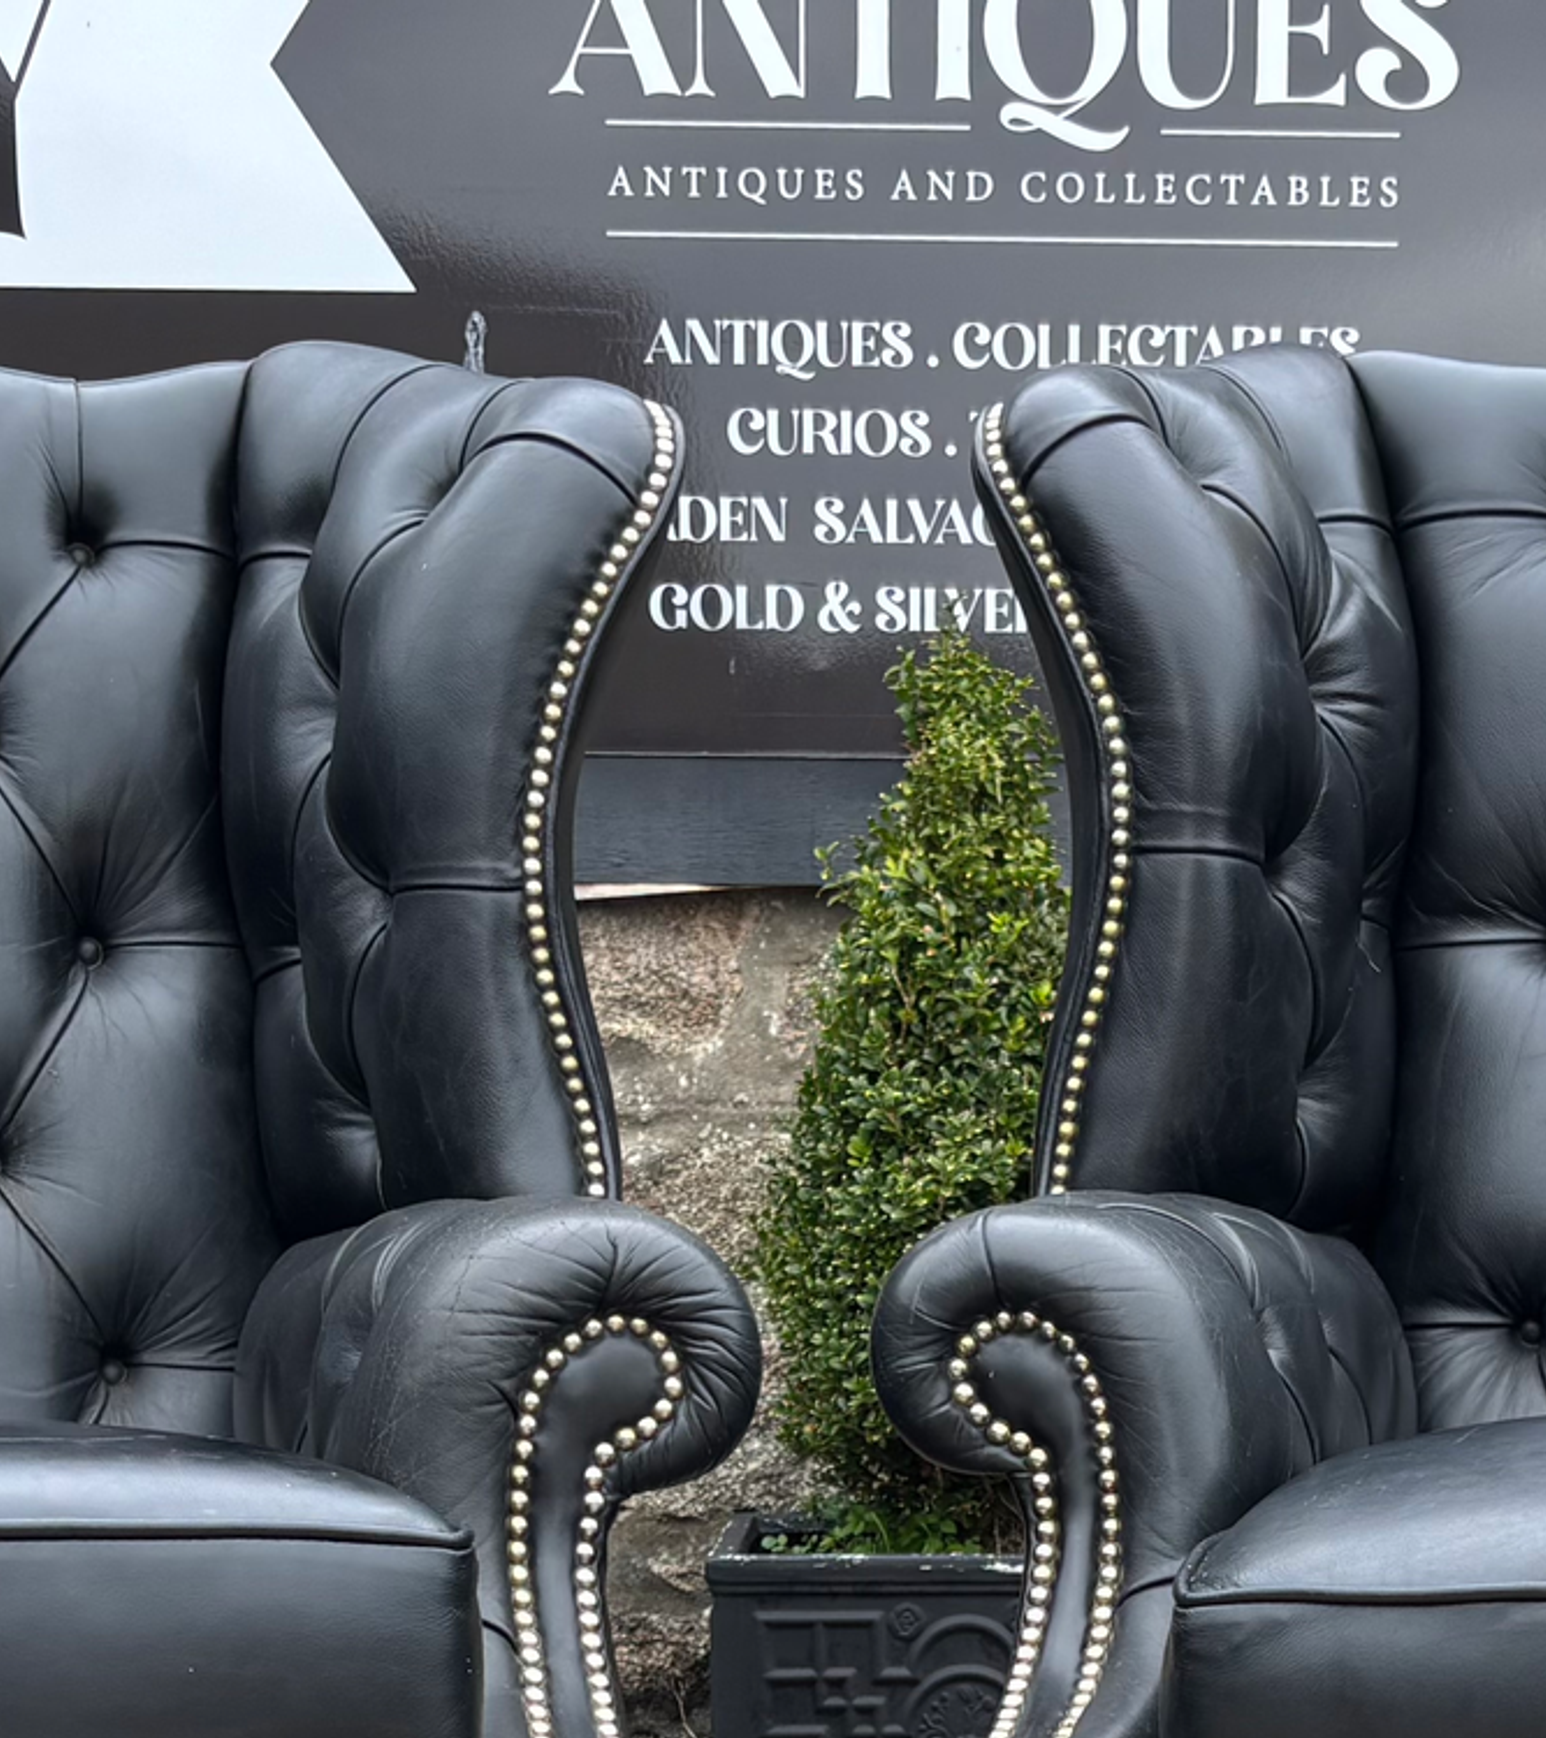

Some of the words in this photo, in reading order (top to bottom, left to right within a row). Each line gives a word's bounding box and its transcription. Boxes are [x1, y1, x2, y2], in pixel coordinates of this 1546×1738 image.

[548, 0, 1459, 152] ANTIQUES
[607, 165, 865, 205] ANTIQUES
[890, 168, 995, 202] AND
[1019, 171, 1399, 208] COLLECTABLES
[666, 495, 789, 544] DEN
[649, 583, 804, 632] GOLD
[817, 580, 862, 633] &
